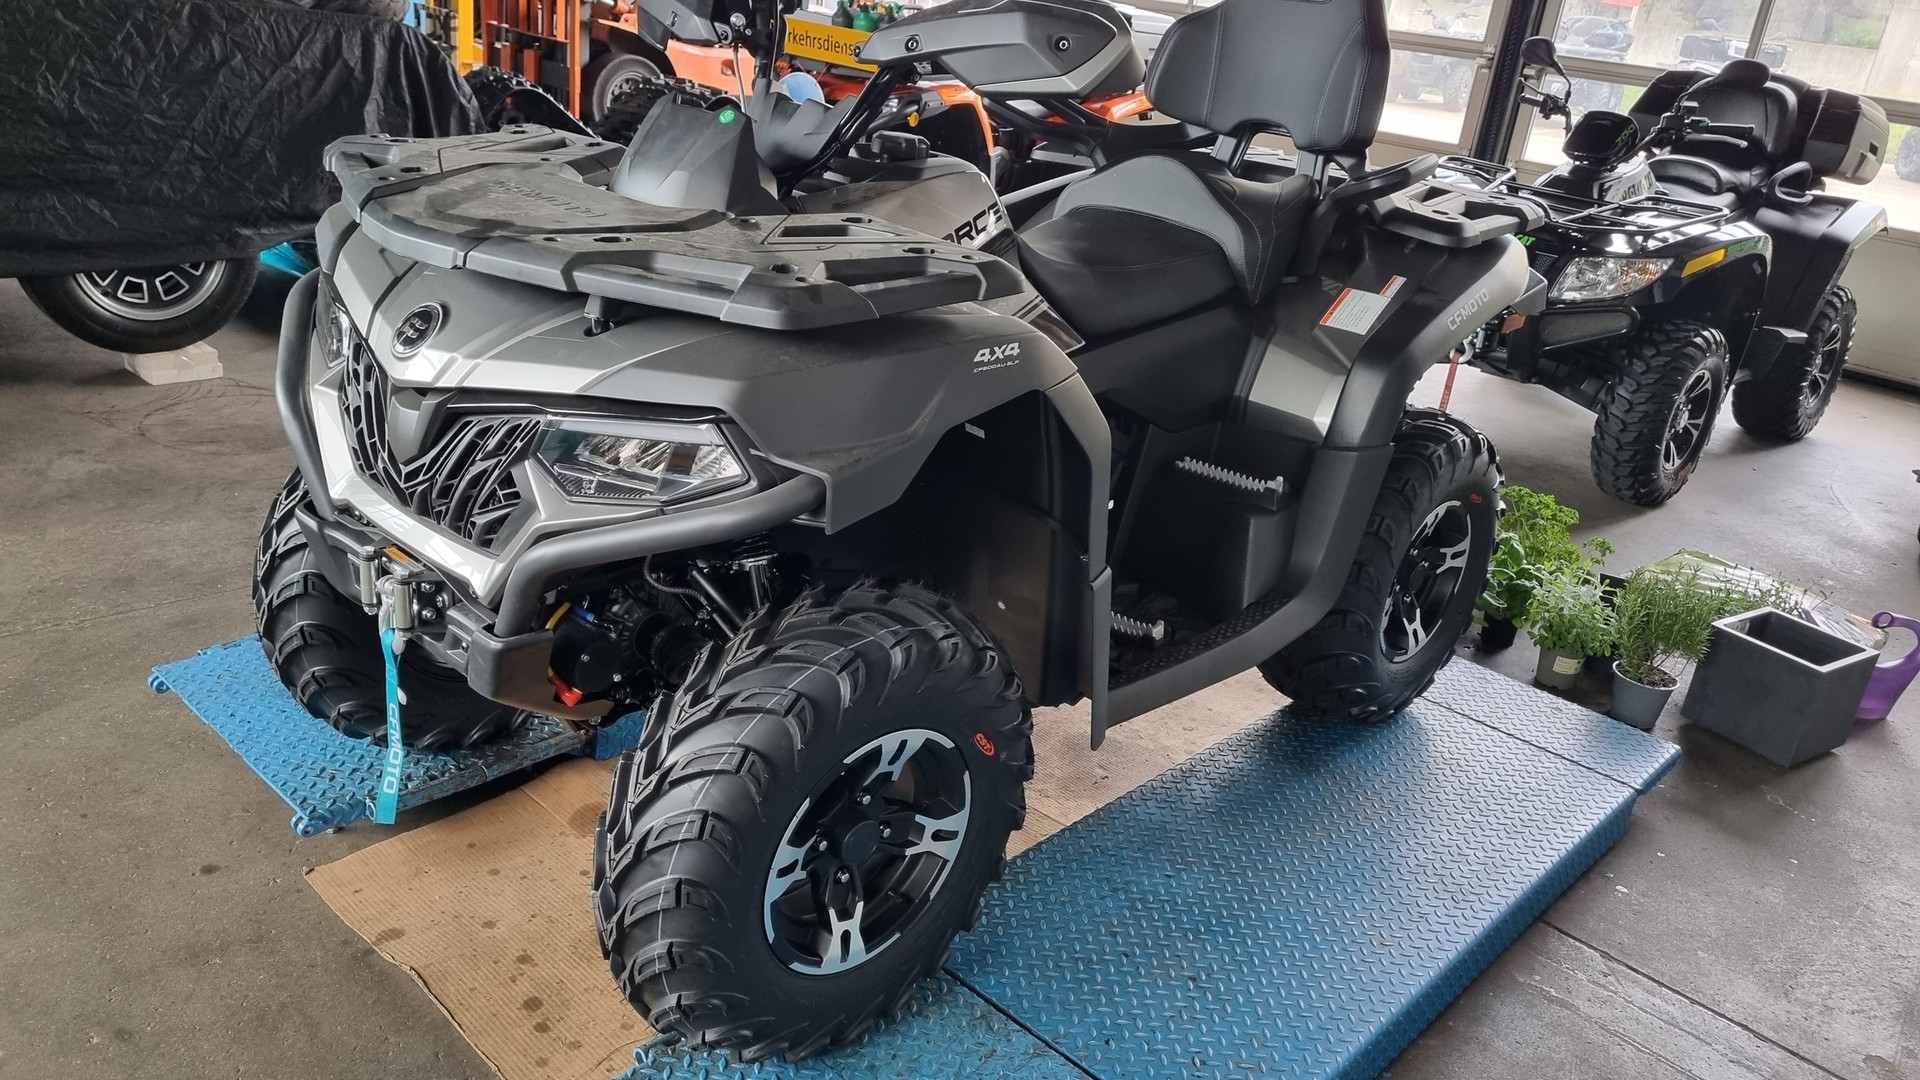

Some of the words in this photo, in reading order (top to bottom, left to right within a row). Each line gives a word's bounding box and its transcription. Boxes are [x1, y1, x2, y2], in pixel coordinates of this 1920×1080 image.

[1447, 288, 1490, 331] CFMOTO
[383, 702, 402, 794] CFMOTO
[975, 733, 993, 754] CST
